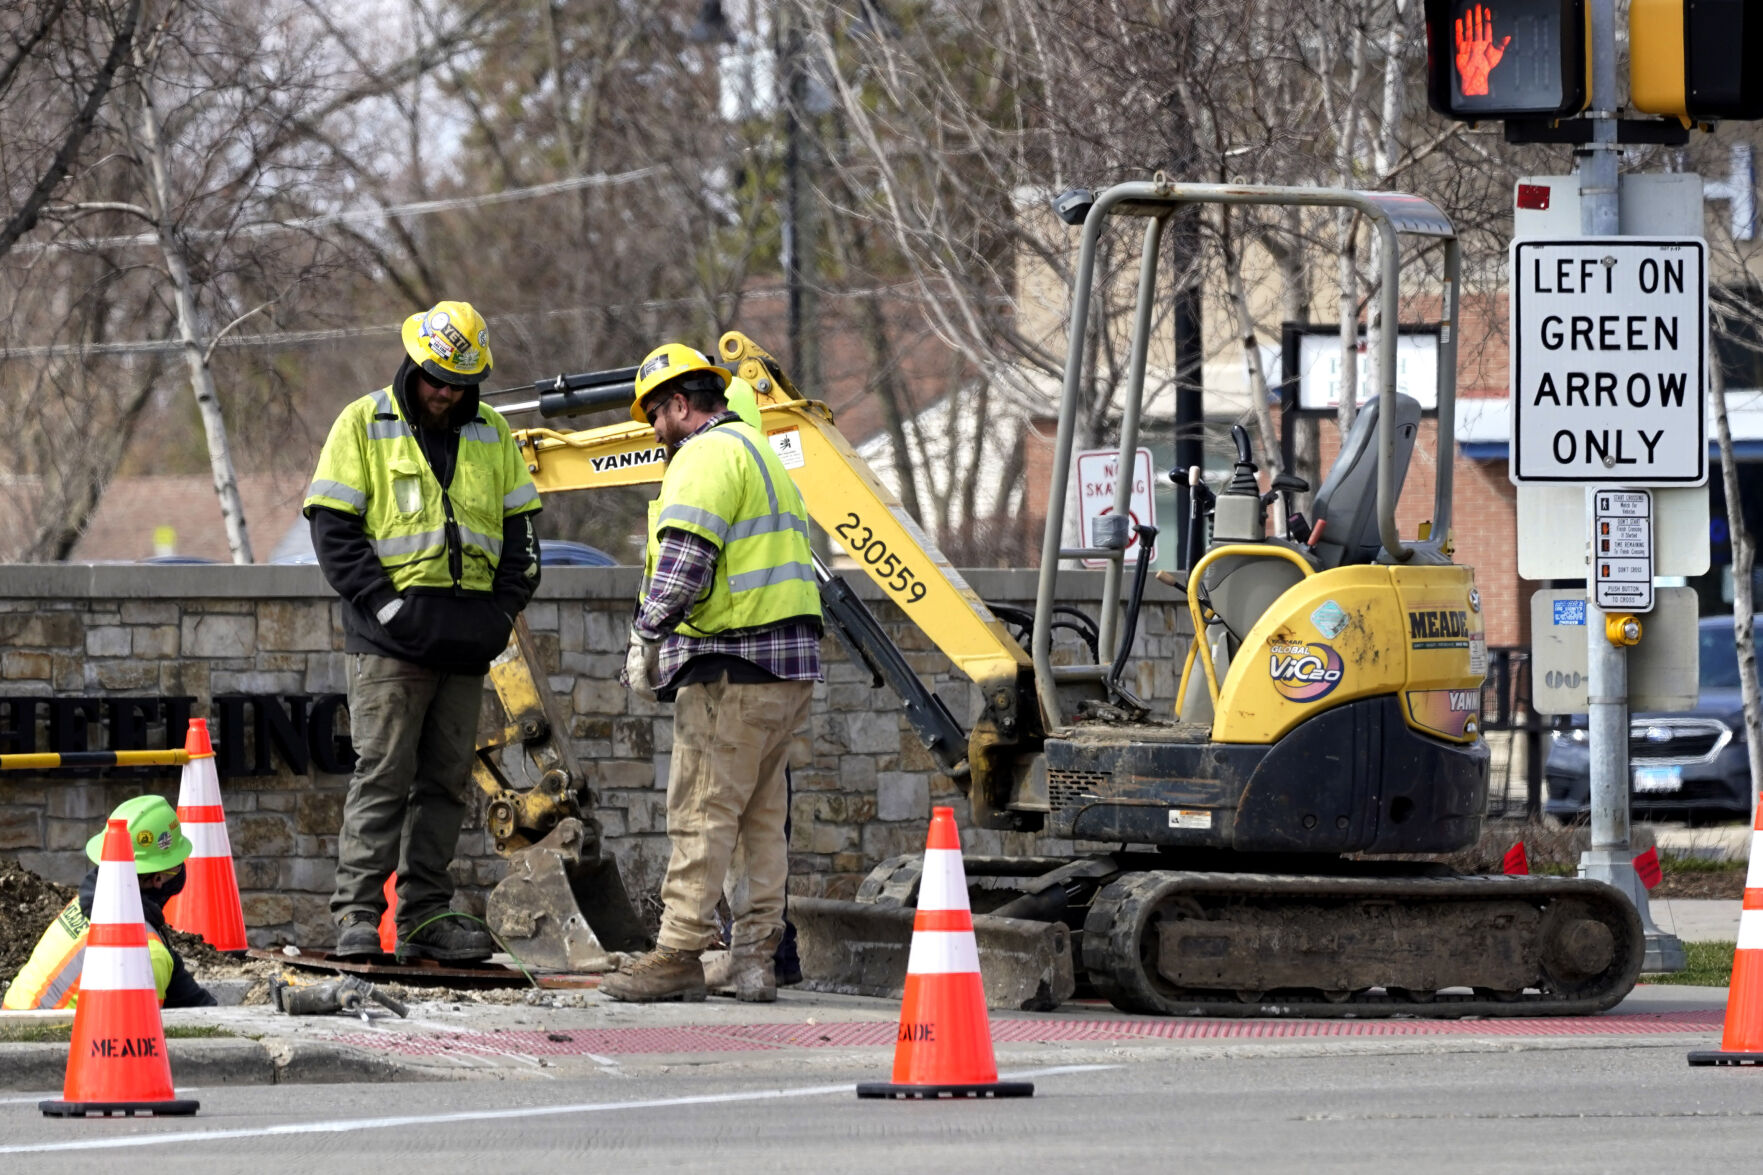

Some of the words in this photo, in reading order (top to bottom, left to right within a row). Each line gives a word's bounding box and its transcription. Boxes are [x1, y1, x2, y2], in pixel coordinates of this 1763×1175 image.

[1534, 258, 1618, 294] LEFT
[1638, 258, 1684, 294] ON
[443, 325, 470, 353] YETI
[1540, 315, 1678, 351] GREEN
[1533, 372, 1688, 408] ARROW
[1552, 429, 1665, 465] ONLY
[834, 512, 927, 604] 230559
[1408, 610, 1469, 639] MEADE
[1271, 645, 1310, 655] GLOBAL
[91, 1037, 159, 1057] MEADE
